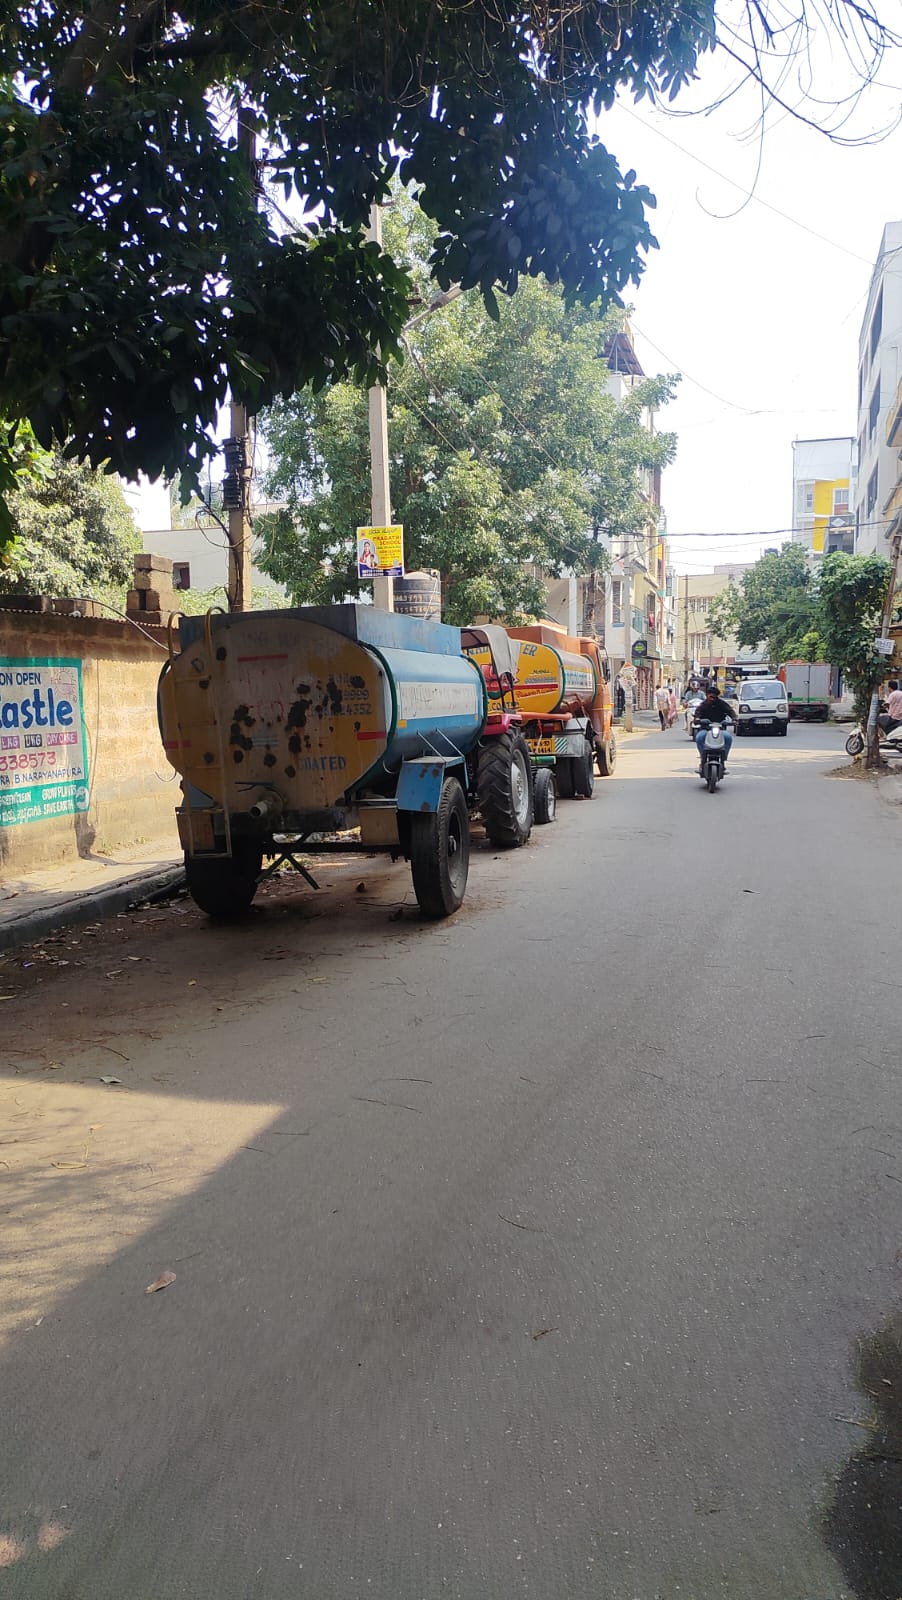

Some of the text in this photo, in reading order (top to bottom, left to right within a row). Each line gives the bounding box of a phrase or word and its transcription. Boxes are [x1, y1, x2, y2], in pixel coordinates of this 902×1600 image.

[16, 672, 41, 686] OPEN
[0, 687, 73, 729] astle
[25, 734, 41, 747] UKG
[0, 751, 56, 772] 338573
